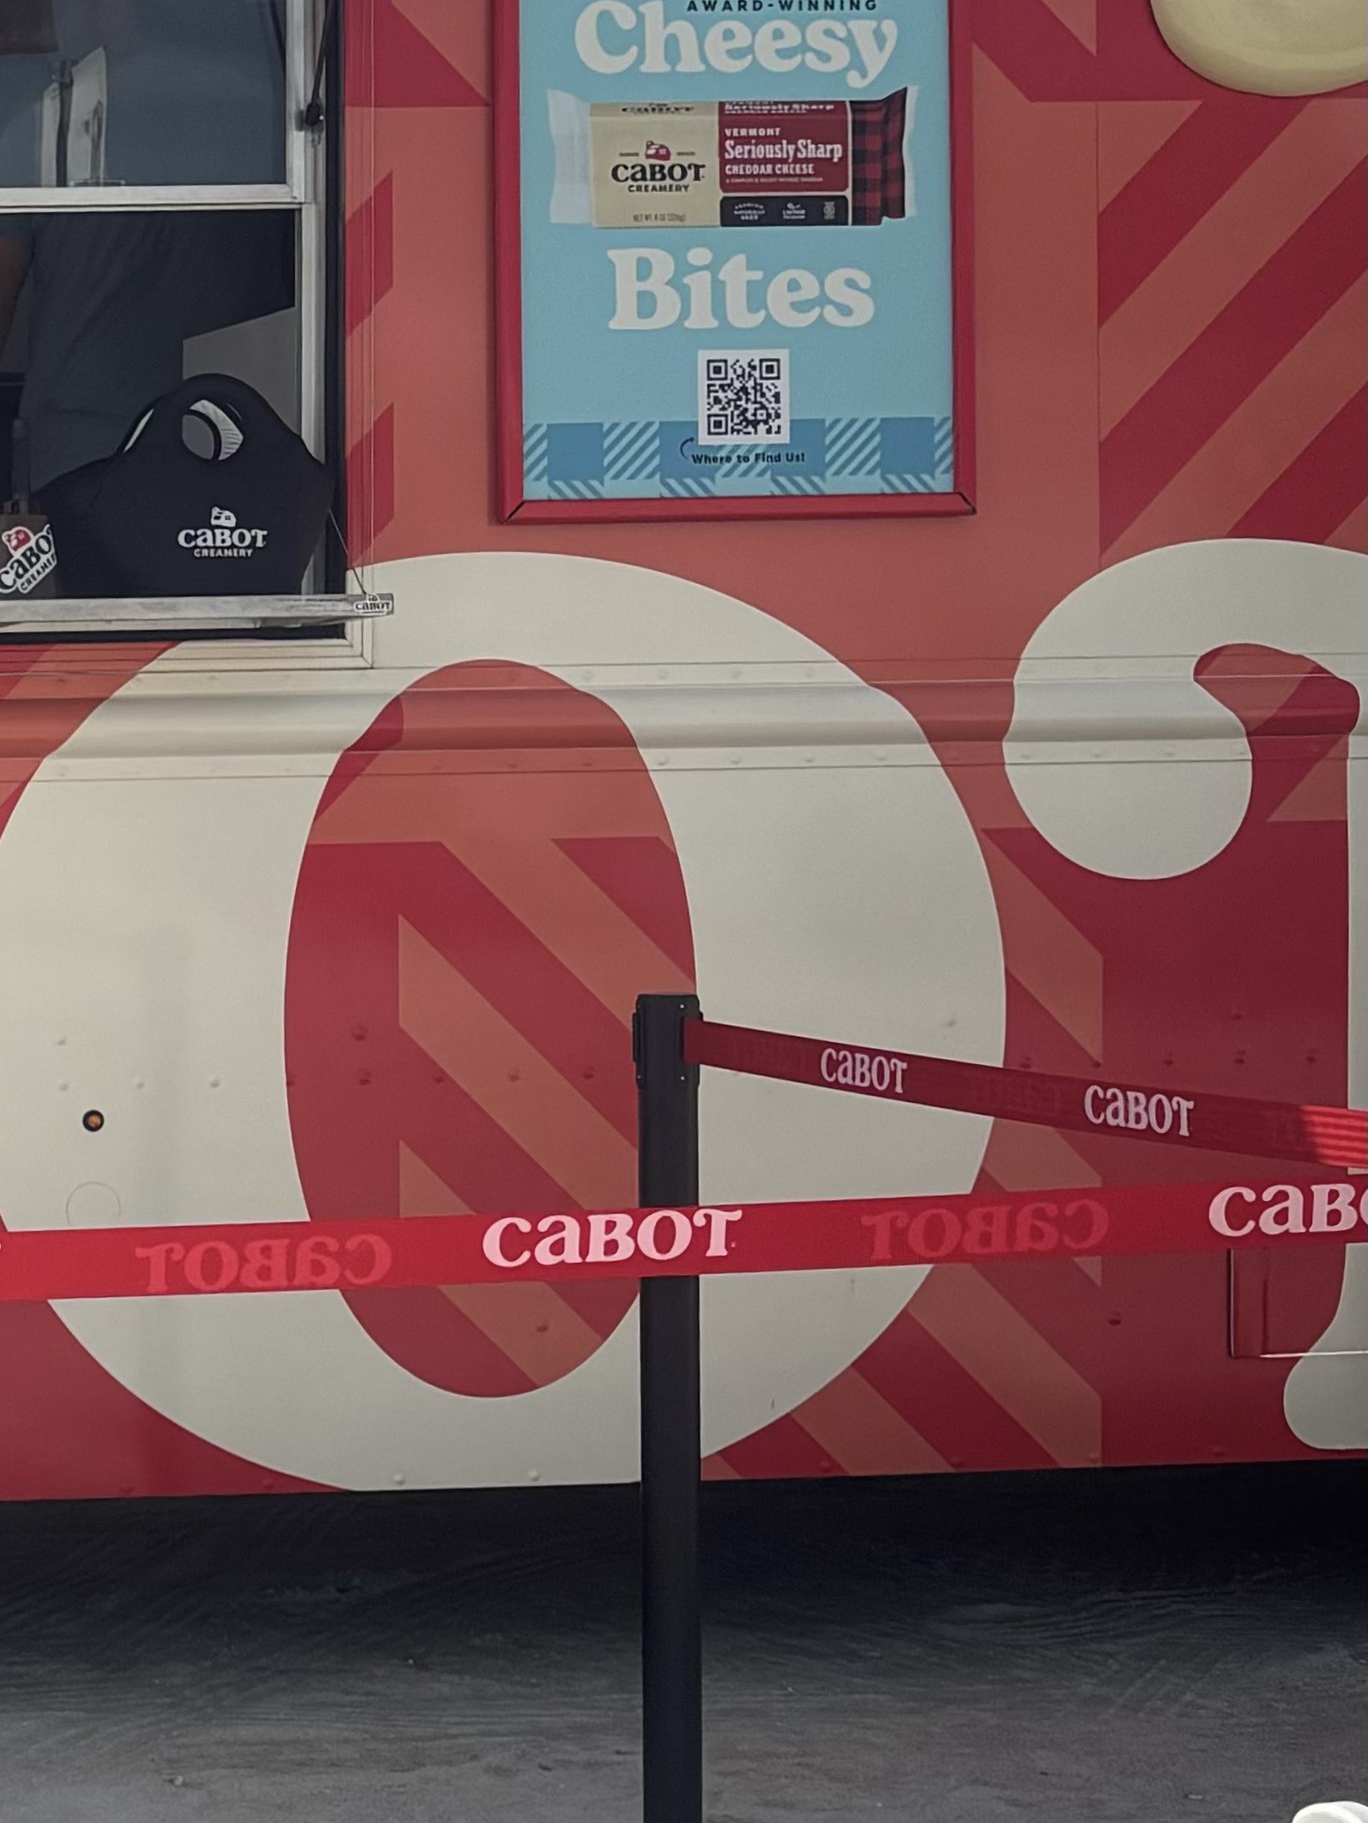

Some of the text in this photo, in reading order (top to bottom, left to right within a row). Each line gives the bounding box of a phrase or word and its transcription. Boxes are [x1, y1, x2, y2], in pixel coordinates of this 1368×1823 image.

[686, 0, 878, 12] AWARD-WINNING
[574, 0, 899, 89] Cheesy
[724, 128, 781, 137] VERMONT
[724, 139, 843, 163] Seriously Sharp
[725, 164, 815, 175] CHEDDAR CHEESE
[627, 184, 690, 193] CREAMERY
[606, 247, 875, 330] Bites
[691, 454, 732, 465] Where
[737, 455, 750, 463] to
[754, 452, 781, 463] Find
[193, 548, 253, 558] CREAMERY
[1208, 1182, 1368, 1237] CaB
